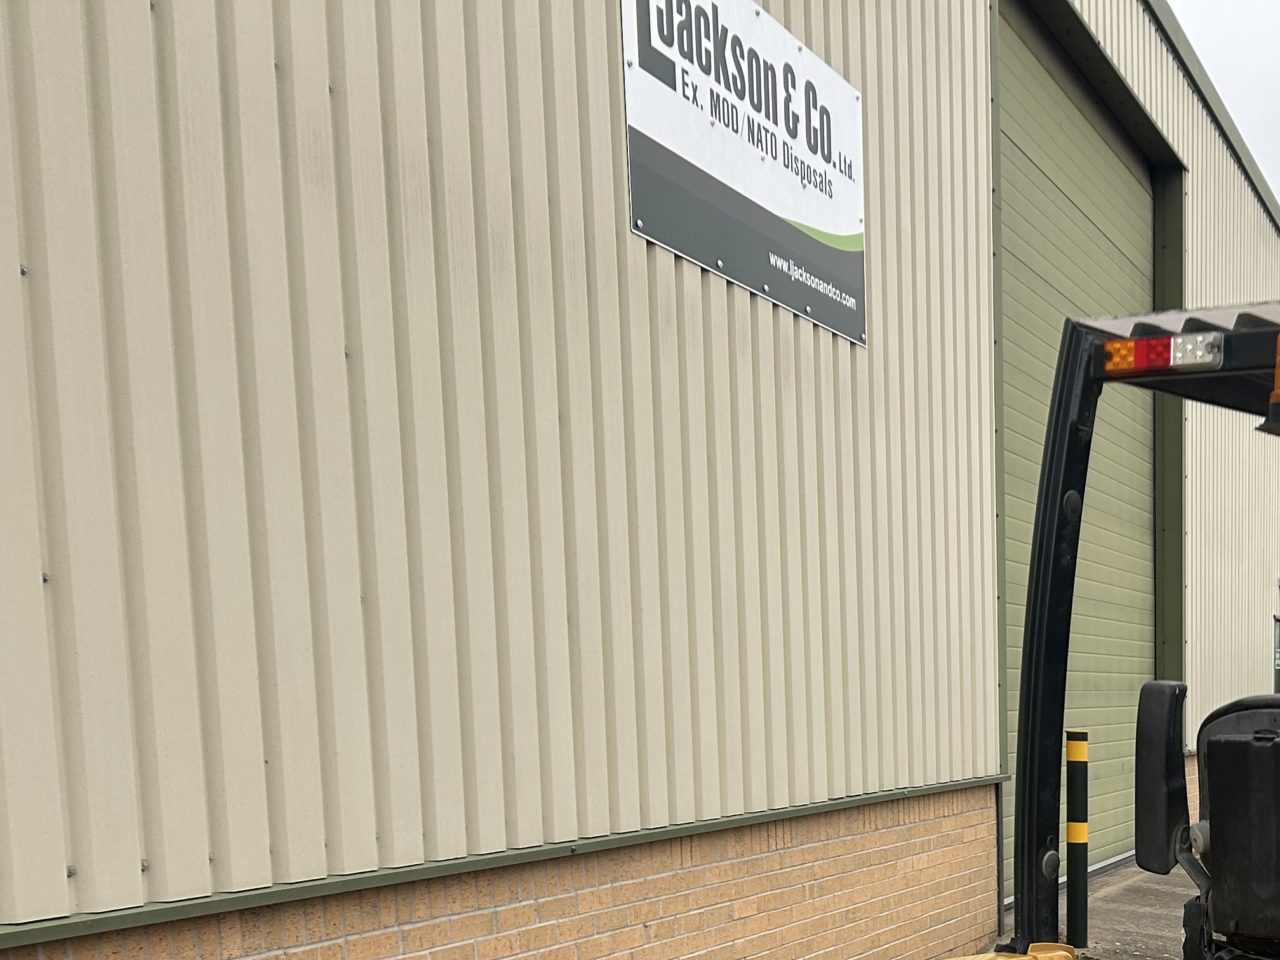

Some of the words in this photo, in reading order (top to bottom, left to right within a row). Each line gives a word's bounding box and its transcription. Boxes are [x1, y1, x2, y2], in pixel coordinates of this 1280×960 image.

[782, 62, 799, 139] &
[838, 151, 855, 182] Ltd.
[782, 139, 833, 199] Disposals
[769, 252, 856, 310] www.ljacksonandco.com
